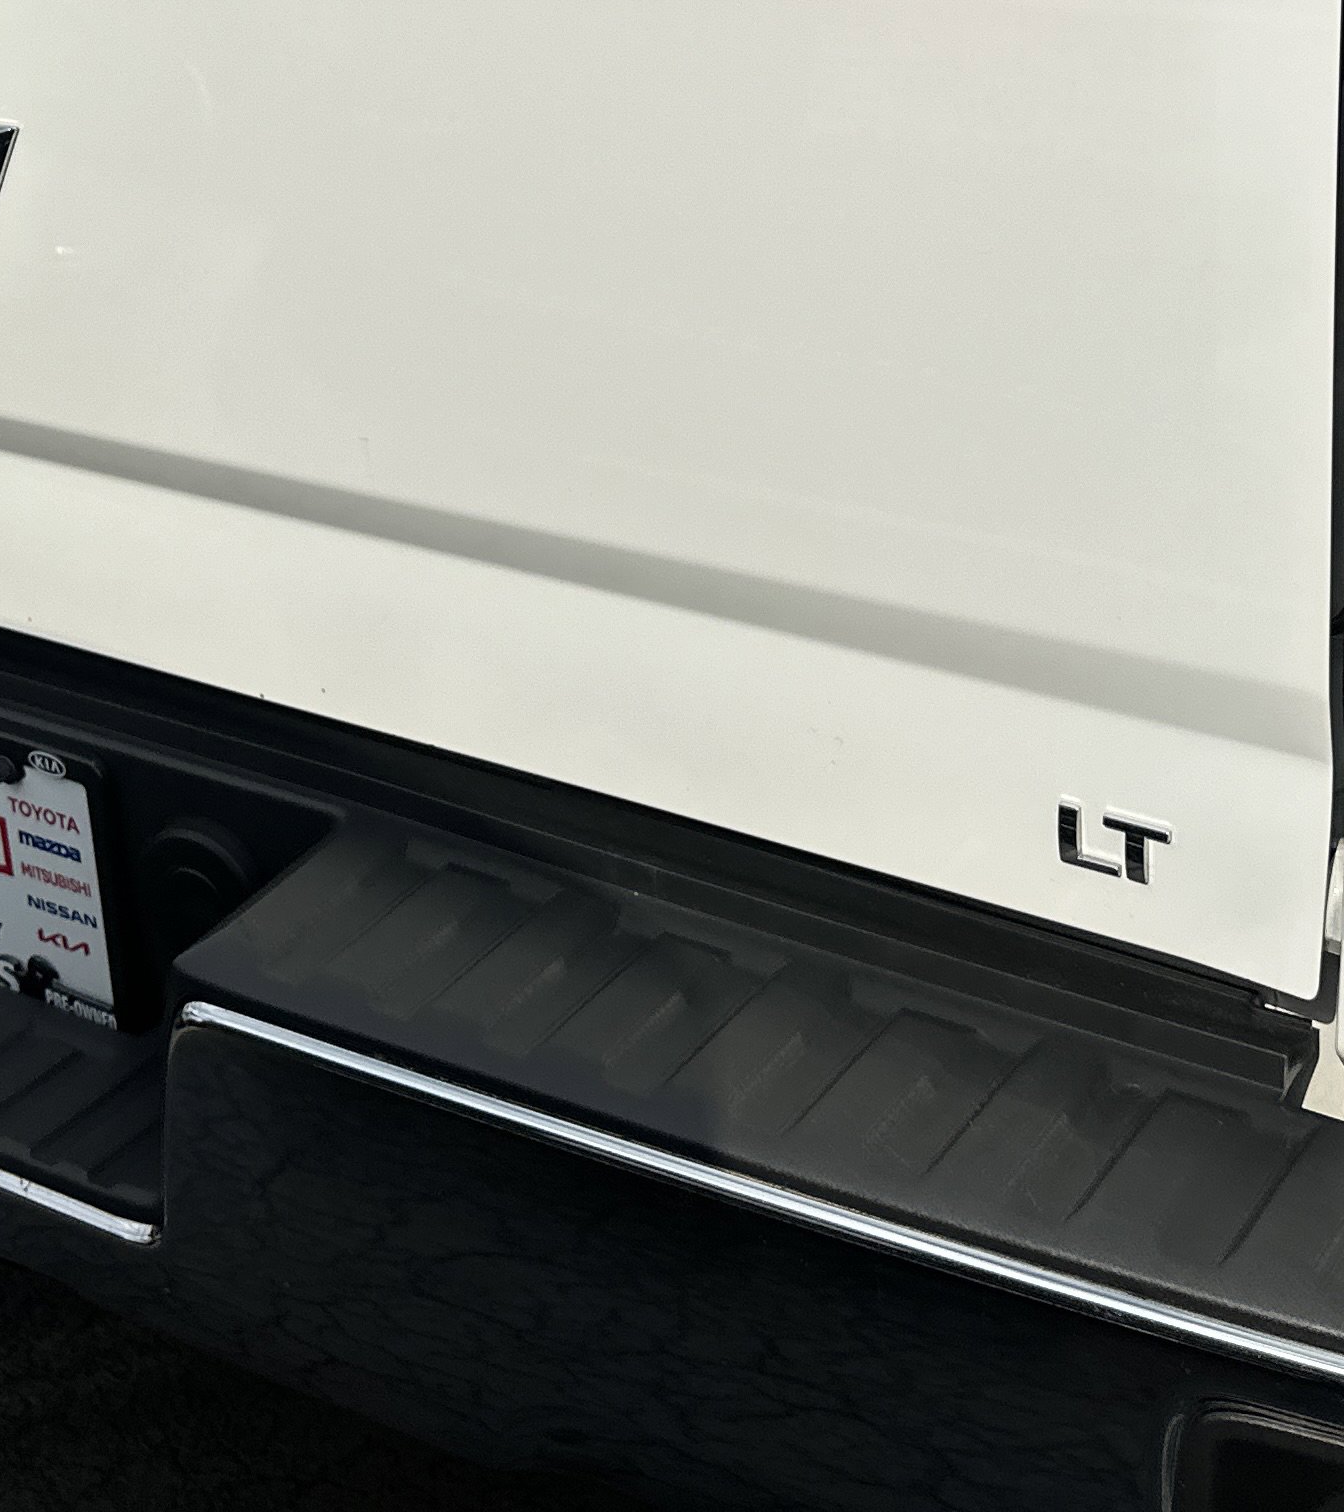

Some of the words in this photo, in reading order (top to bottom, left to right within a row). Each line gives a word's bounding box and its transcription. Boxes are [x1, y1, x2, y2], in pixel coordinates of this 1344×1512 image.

[7, 796, 81, 835] TOYOTA
[1057, 799, 1173, 886] LT
[21, 861, 93, 898] MITSUBISHI
[27, 893, 98, 929] NISSAN
